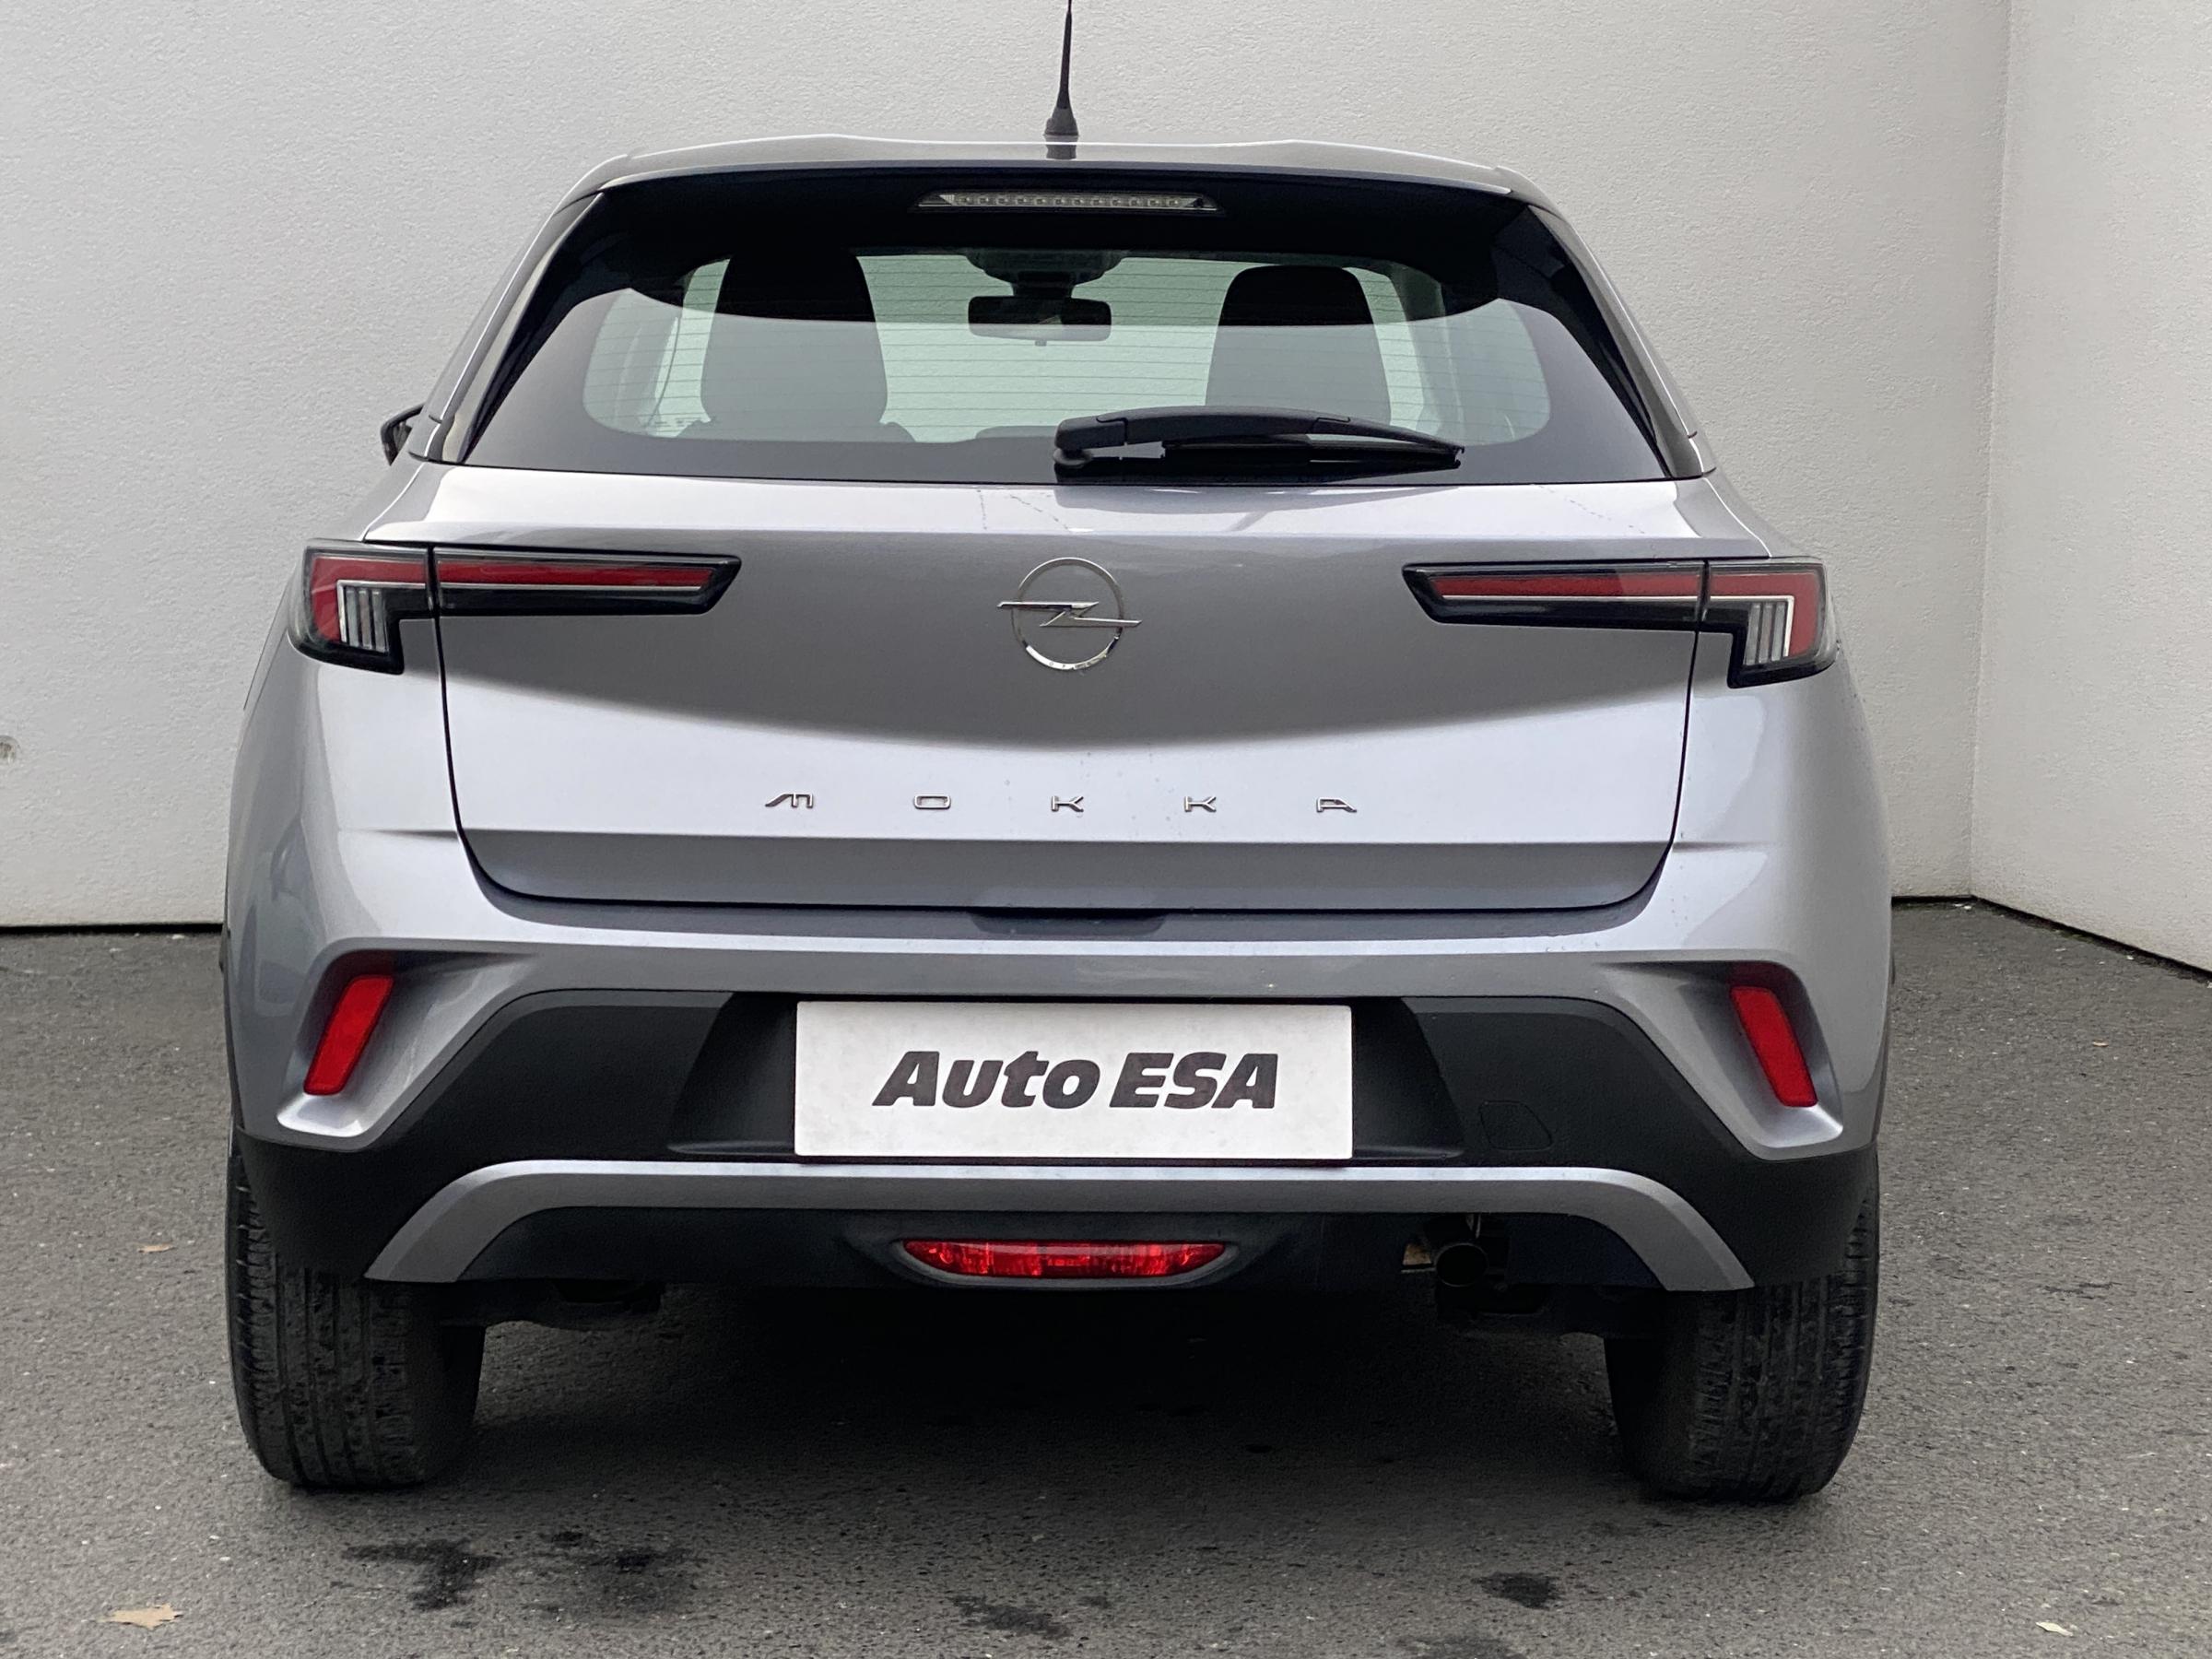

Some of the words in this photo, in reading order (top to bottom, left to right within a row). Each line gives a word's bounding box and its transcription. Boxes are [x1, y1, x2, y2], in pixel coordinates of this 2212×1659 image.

[765, 793, 1357, 813] MOKKA
[872, 1051, 1100, 1109] Auto
[1109, 1052, 1278, 1109] ESA
